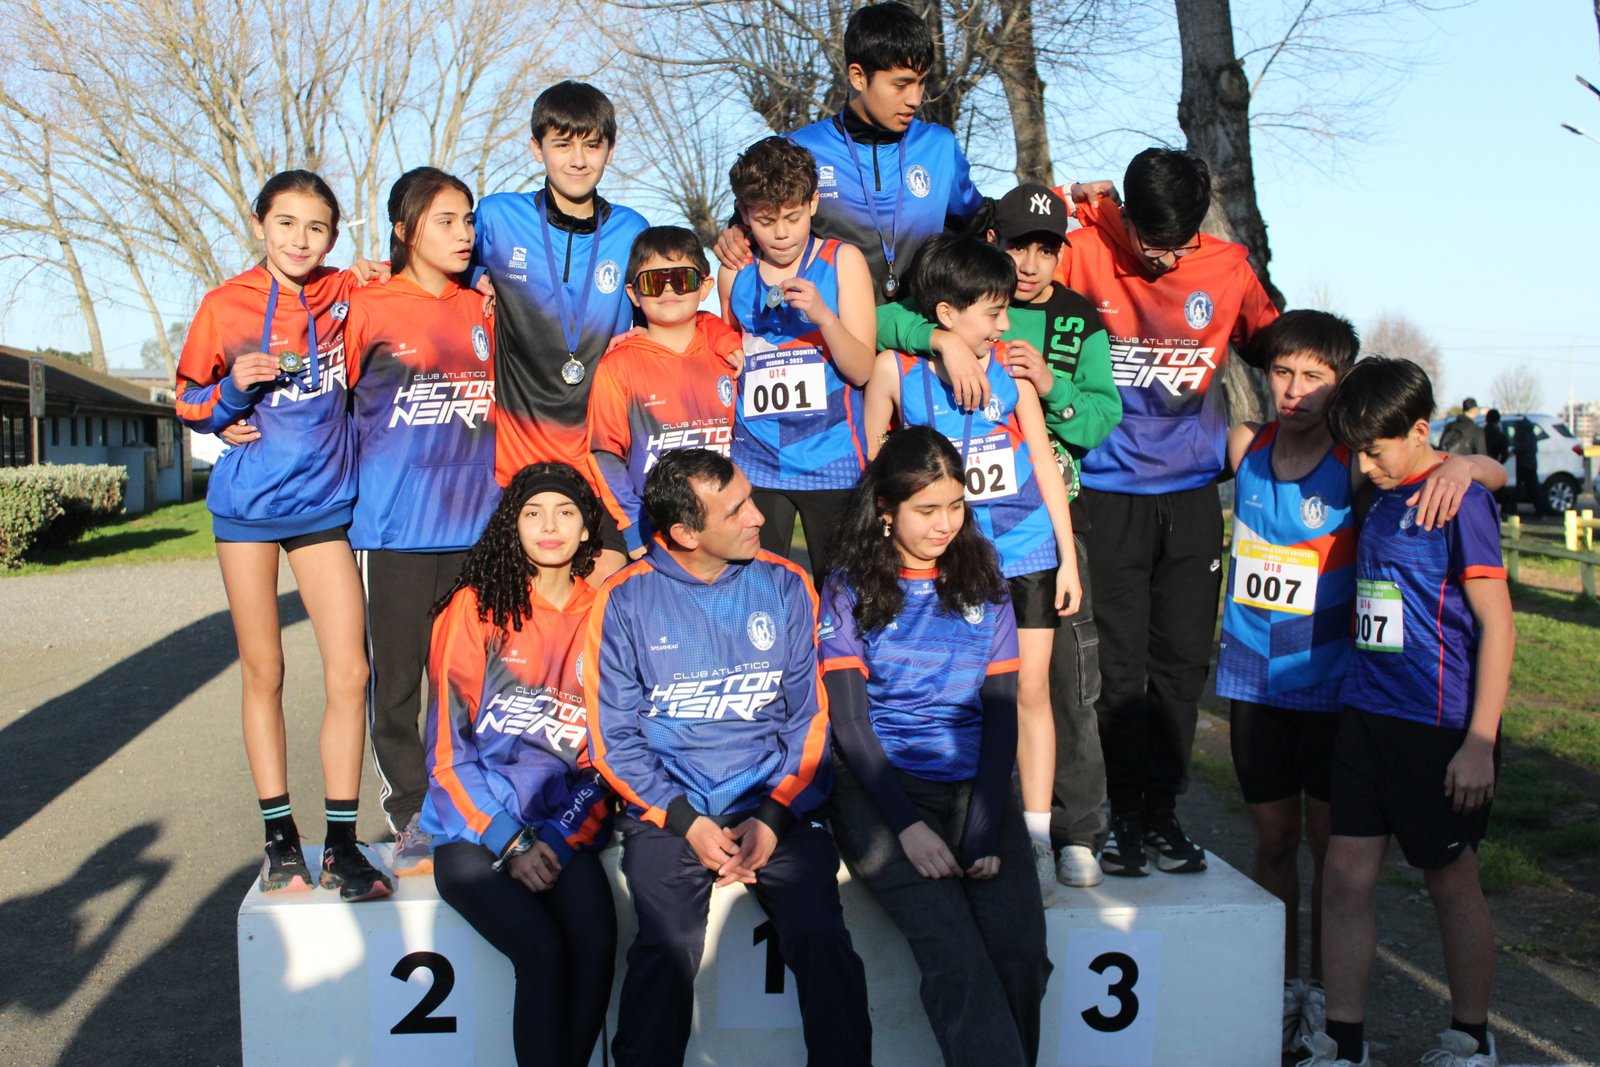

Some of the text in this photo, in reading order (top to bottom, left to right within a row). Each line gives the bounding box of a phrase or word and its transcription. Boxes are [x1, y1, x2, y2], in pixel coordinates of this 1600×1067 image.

[776, 350, 792, 358] CROSS
[792, 348, 818, 356] COUNTRY
[1047, 316, 1085, 379] TICS
[1109, 335, 1199, 346] CLUB ATLETICO
[1110, 344, 1216, 370] ECTOR
[442, 370, 486, 380] ATLETICO
[769, 368, 786, 378] U14
[1111, 363, 1208, 396] EIRA
[393, 380, 496, 404] HECTOR
[754, 380, 812, 412] 001
[388, 399, 492, 429] NEIRA
[662, 418, 729, 430] CLUB ATLETIC
[646, 426, 732, 451] HECTO
[985, 434, 1006, 442] COUNTRY
[969, 456, 980, 466] 14
[966, 464, 1006, 496] 02
[1264, 562, 1282, 573] U18
[1246, 573, 1302, 604] 007
[674, 662, 770, 680] CLUB ATLETICO
[545, 686, 582, 703] ATLETICO
[650, 670, 784, 702] HECTOR
[486, 694, 587, 723] HECTOR
[476, 711, 587, 752] NEIRA
[752, 920, 786, 994] 1
[390, 951, 457, 1035] 2
[1080, 952, 1140, 1033] 3
